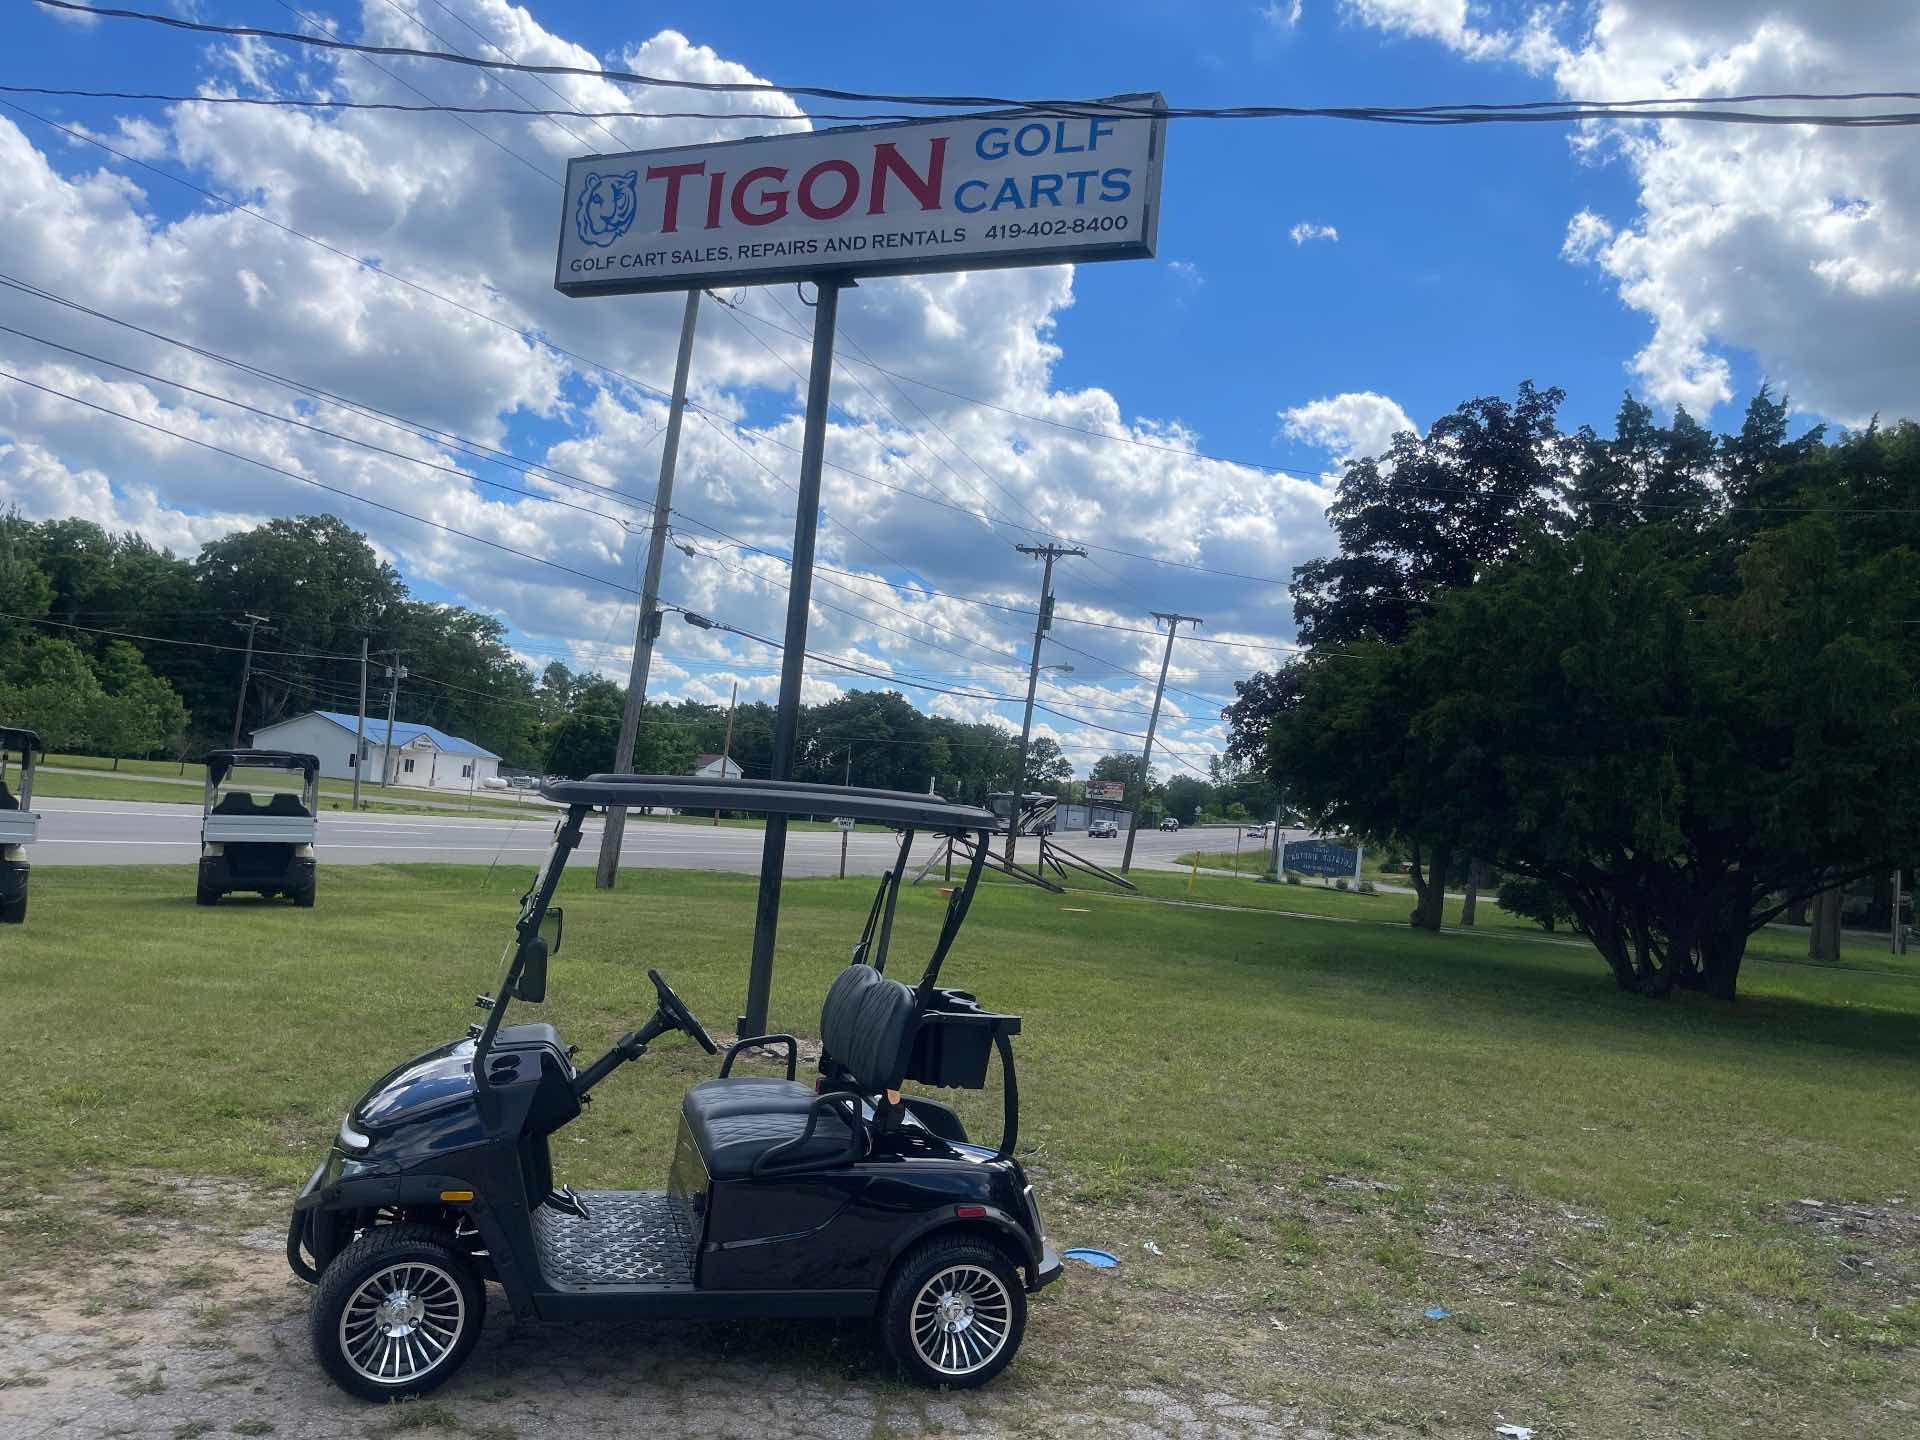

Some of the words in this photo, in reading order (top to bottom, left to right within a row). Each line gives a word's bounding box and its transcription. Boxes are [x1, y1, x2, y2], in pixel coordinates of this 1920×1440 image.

[975, 116, 1121, 161] GOLF
[646, 136, 950, 233] TIGON
[954, 167, 1133, 214] CARTS
[570, 255, 616, 272] GOLF
[619, 251, 668, 268] CART
[671, 246, 733, 264] SALES,
[738, 239, 818, 260] REPAIRS
[823, 235, 866, 251] AND
[872, 227, 967, 249] RENTALS
[984, 215, 1128, 241] 419-402-8400
